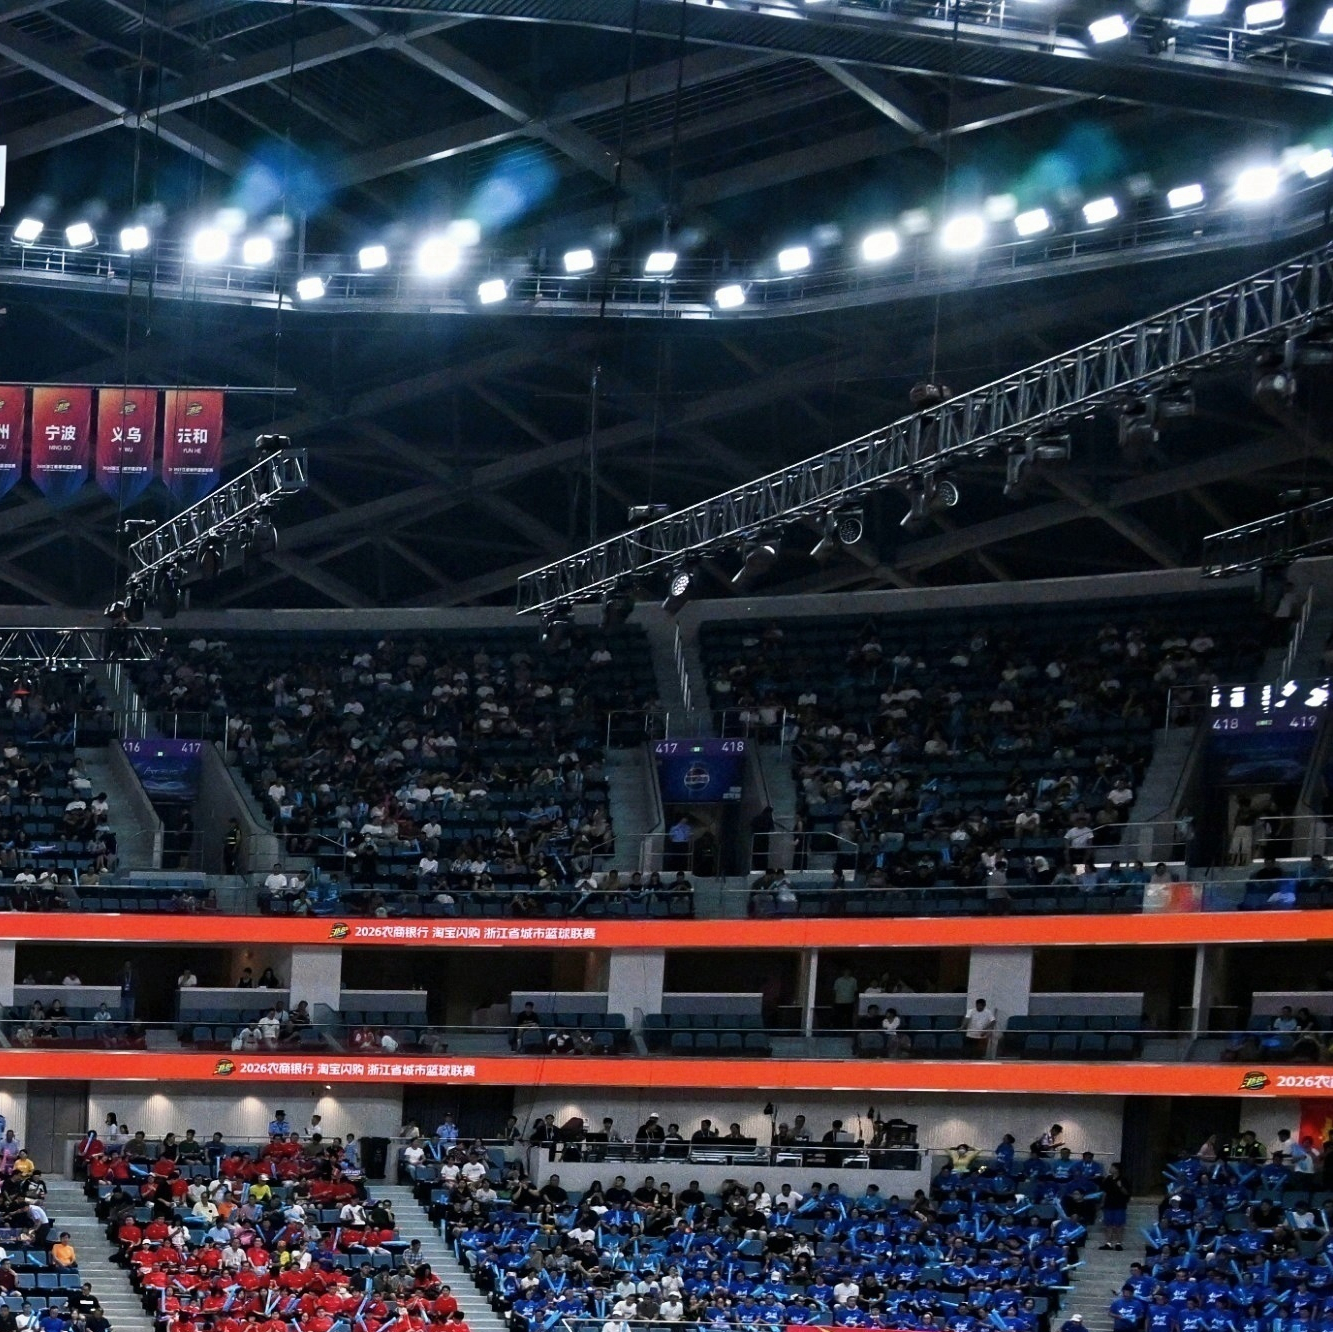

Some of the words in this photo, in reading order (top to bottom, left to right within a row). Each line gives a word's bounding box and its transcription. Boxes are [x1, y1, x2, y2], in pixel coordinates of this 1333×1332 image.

[45, 425, 76, 441] 宁波
[111, 426, 142, 443] 义乌
[177, 428, 208, 444] 云和
[1212, 718, 1239, 730] 418
[1289, 715, 1318, 727] 419
[181, 742, 201, 753] 417
[655, 743, 678, 753] 417
[721, 741, 745, 752] 418
[355, 926, 429, 938] 2026农商银行
[432, 926, 481, 939] 淘宝闪购
[483, 926, 596, 940] 浙江省城市篮球联赛
[240, 1062, 314, 1075] 2026农商银行
[317, 1062, 364, 1075] 淘宝闪购
[367, 1063, 475, 1077] 浙江省城市篮球联赛
